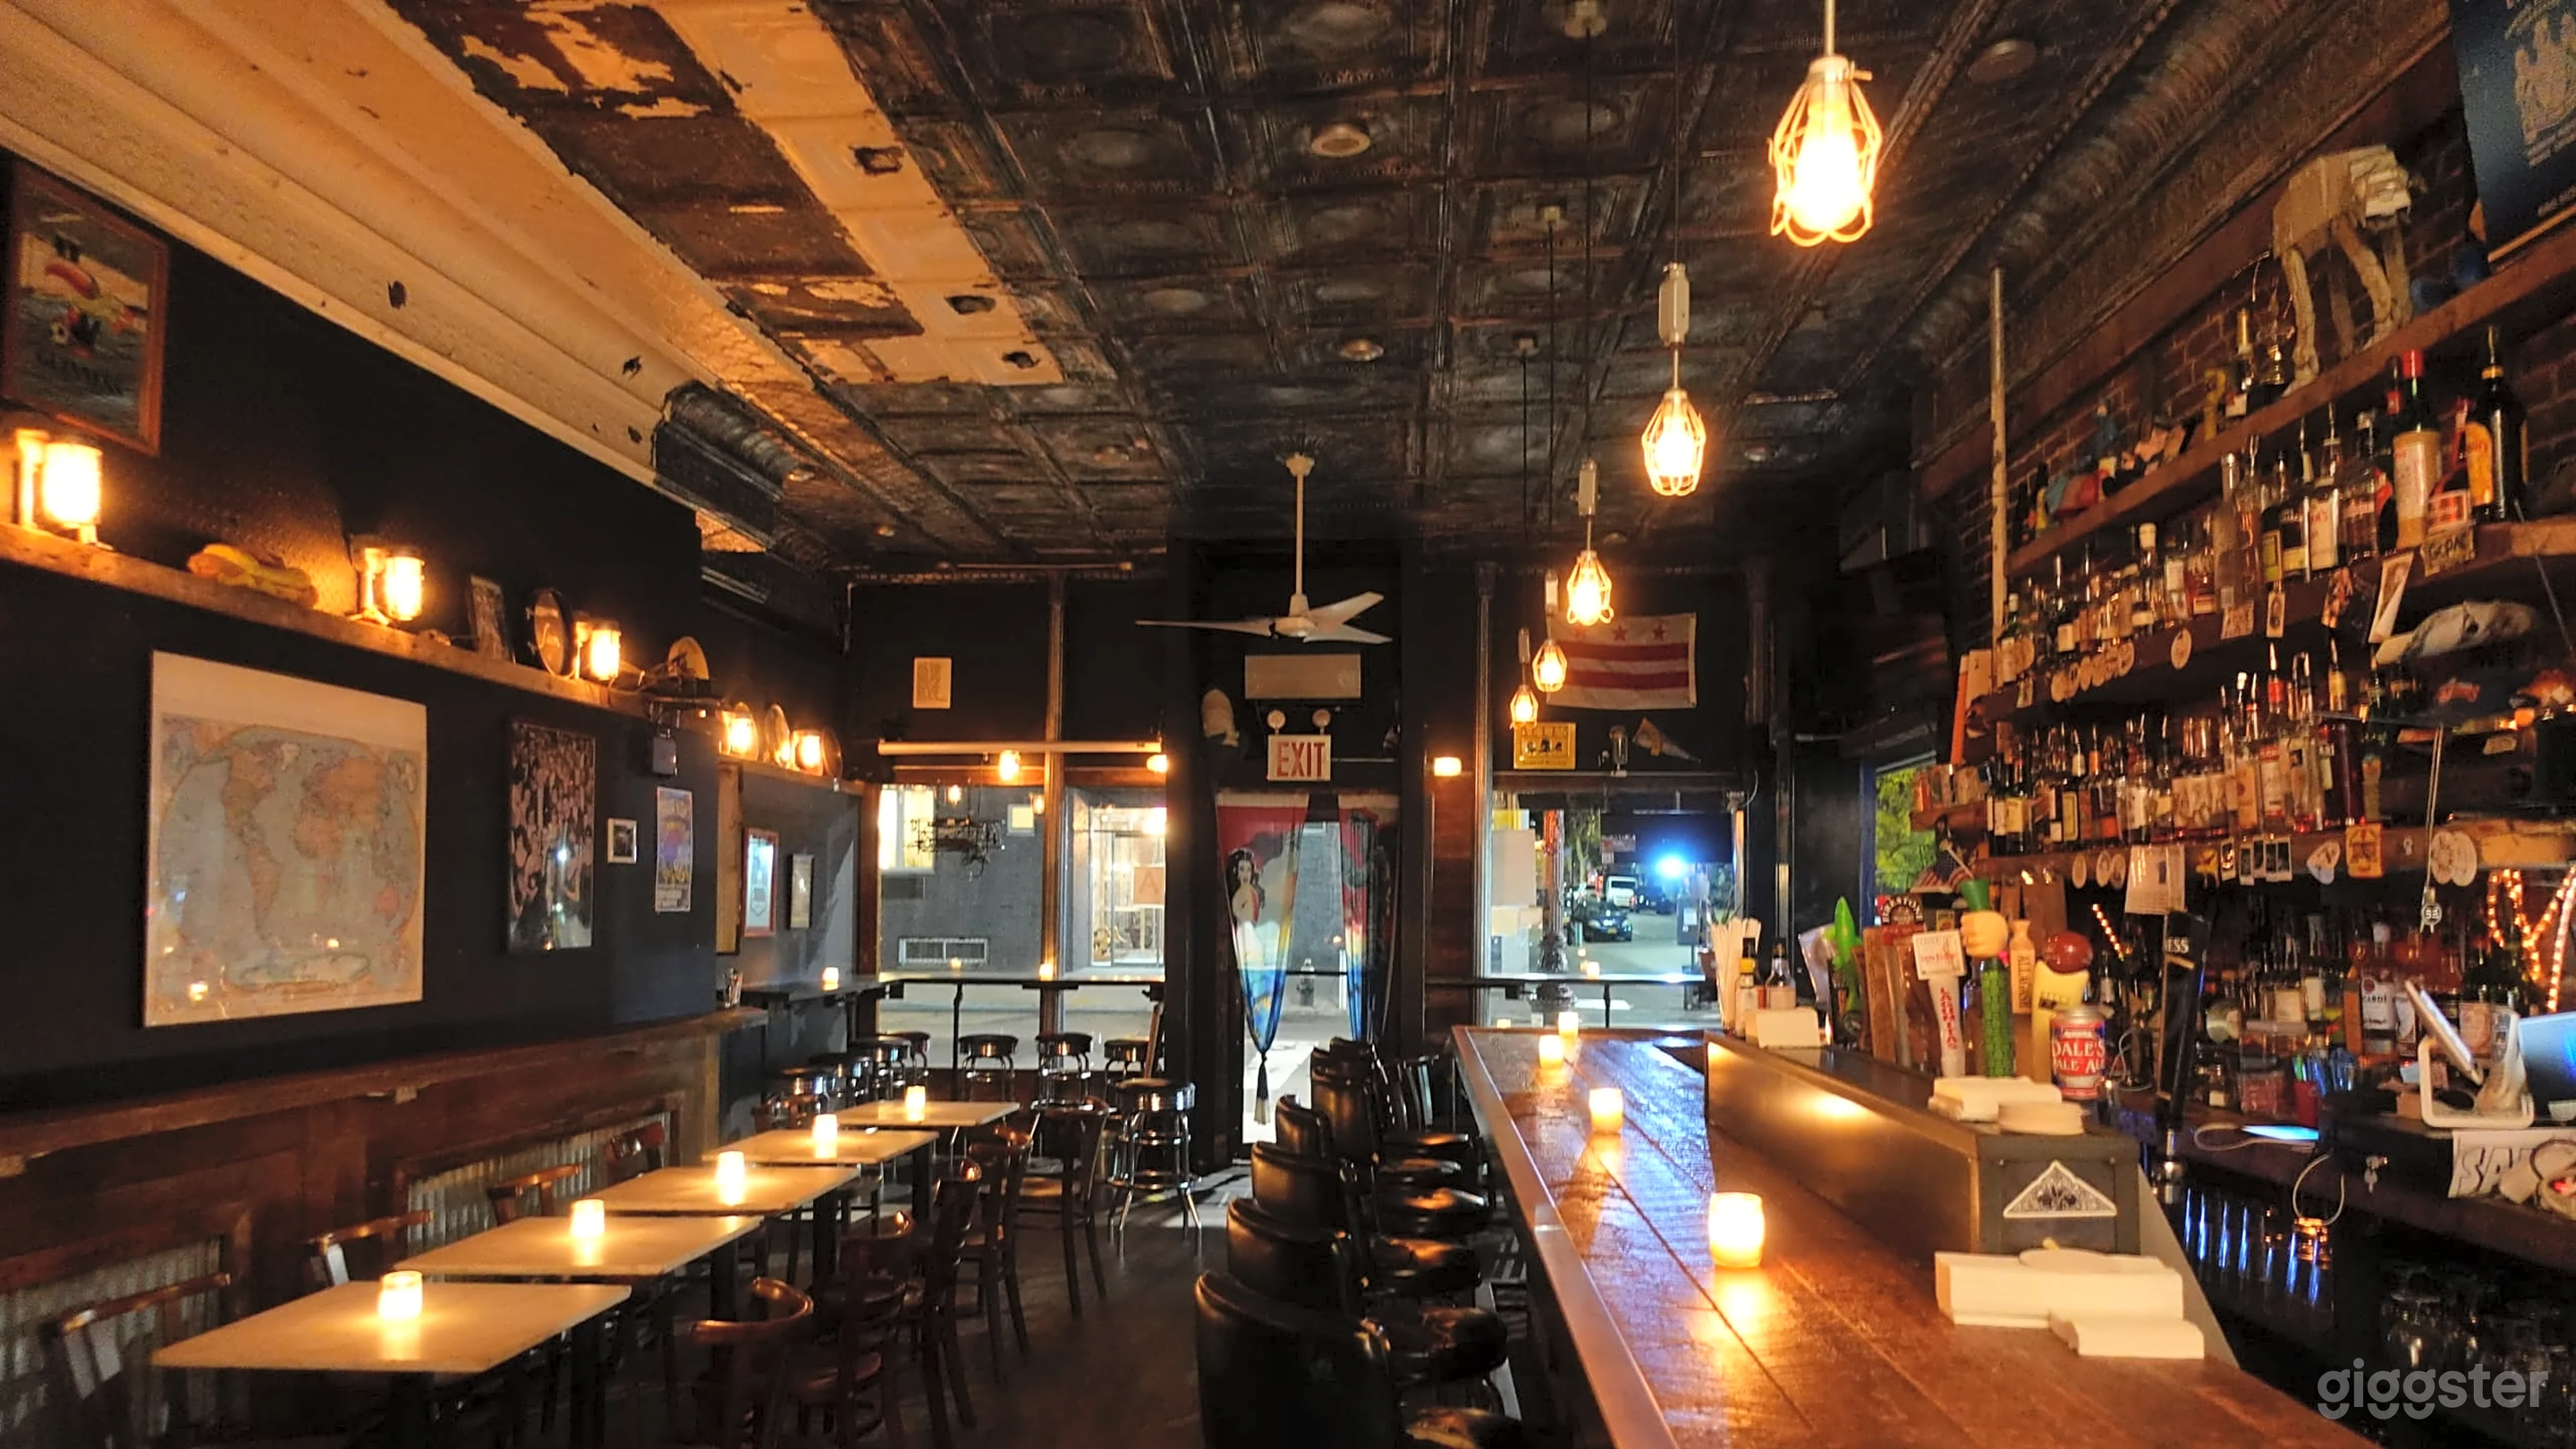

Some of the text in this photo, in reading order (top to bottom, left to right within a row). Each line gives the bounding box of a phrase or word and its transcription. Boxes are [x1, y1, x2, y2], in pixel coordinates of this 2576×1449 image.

[1276, 741, 1326, 778] EXIT
[1139, 869, 1160, 895] A
[2052, 1038, 2106, 1057] DALE'S
